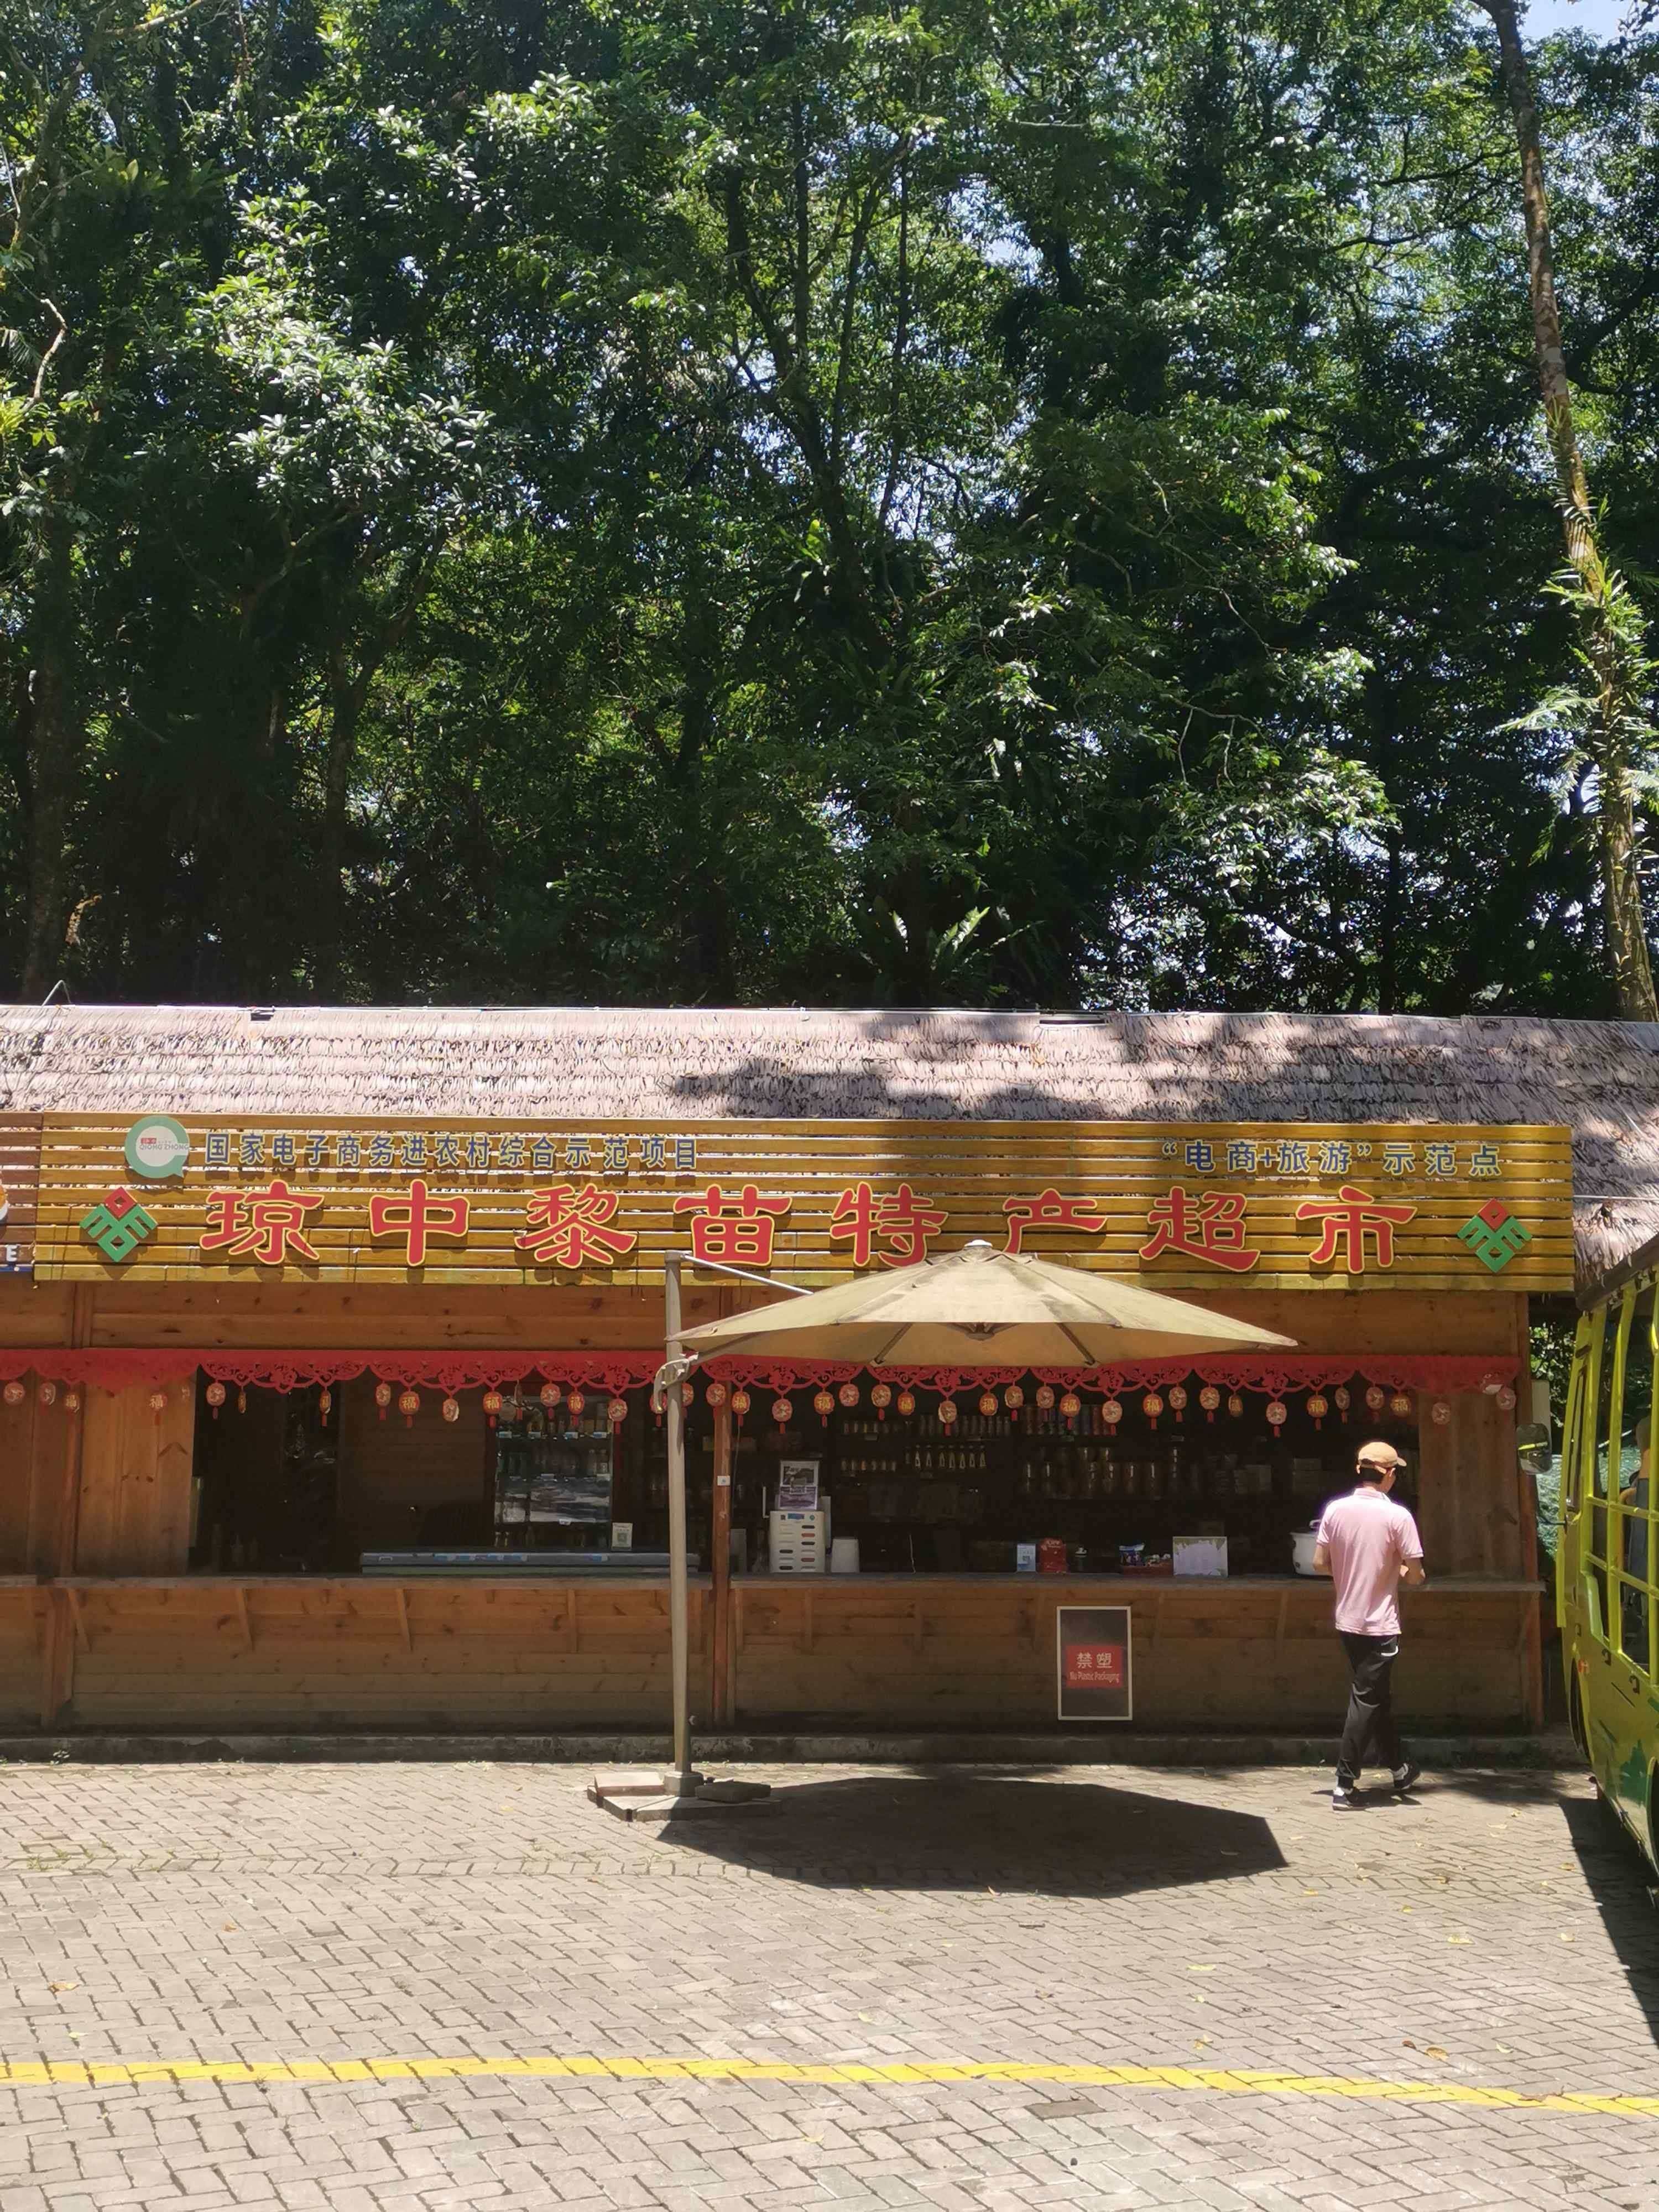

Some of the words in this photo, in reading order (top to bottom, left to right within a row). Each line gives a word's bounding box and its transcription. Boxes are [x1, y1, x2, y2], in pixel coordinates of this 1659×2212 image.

[205, 1132, 697, 1170] 国家电子商务进农村综合示范项目
[199, 1178, 1418, 1274] 琼中黎苗特产超市
[402, 1397, 416, 1409] 福
[486, 1397, 500, 1409] 福
[570, 1397, 582, 1409] 福
[817, 1397, 831, 1409] 福
[1145, 1399, 1160, 1412] 福
[1077, 1652, 1113, 1669] 禁塑
